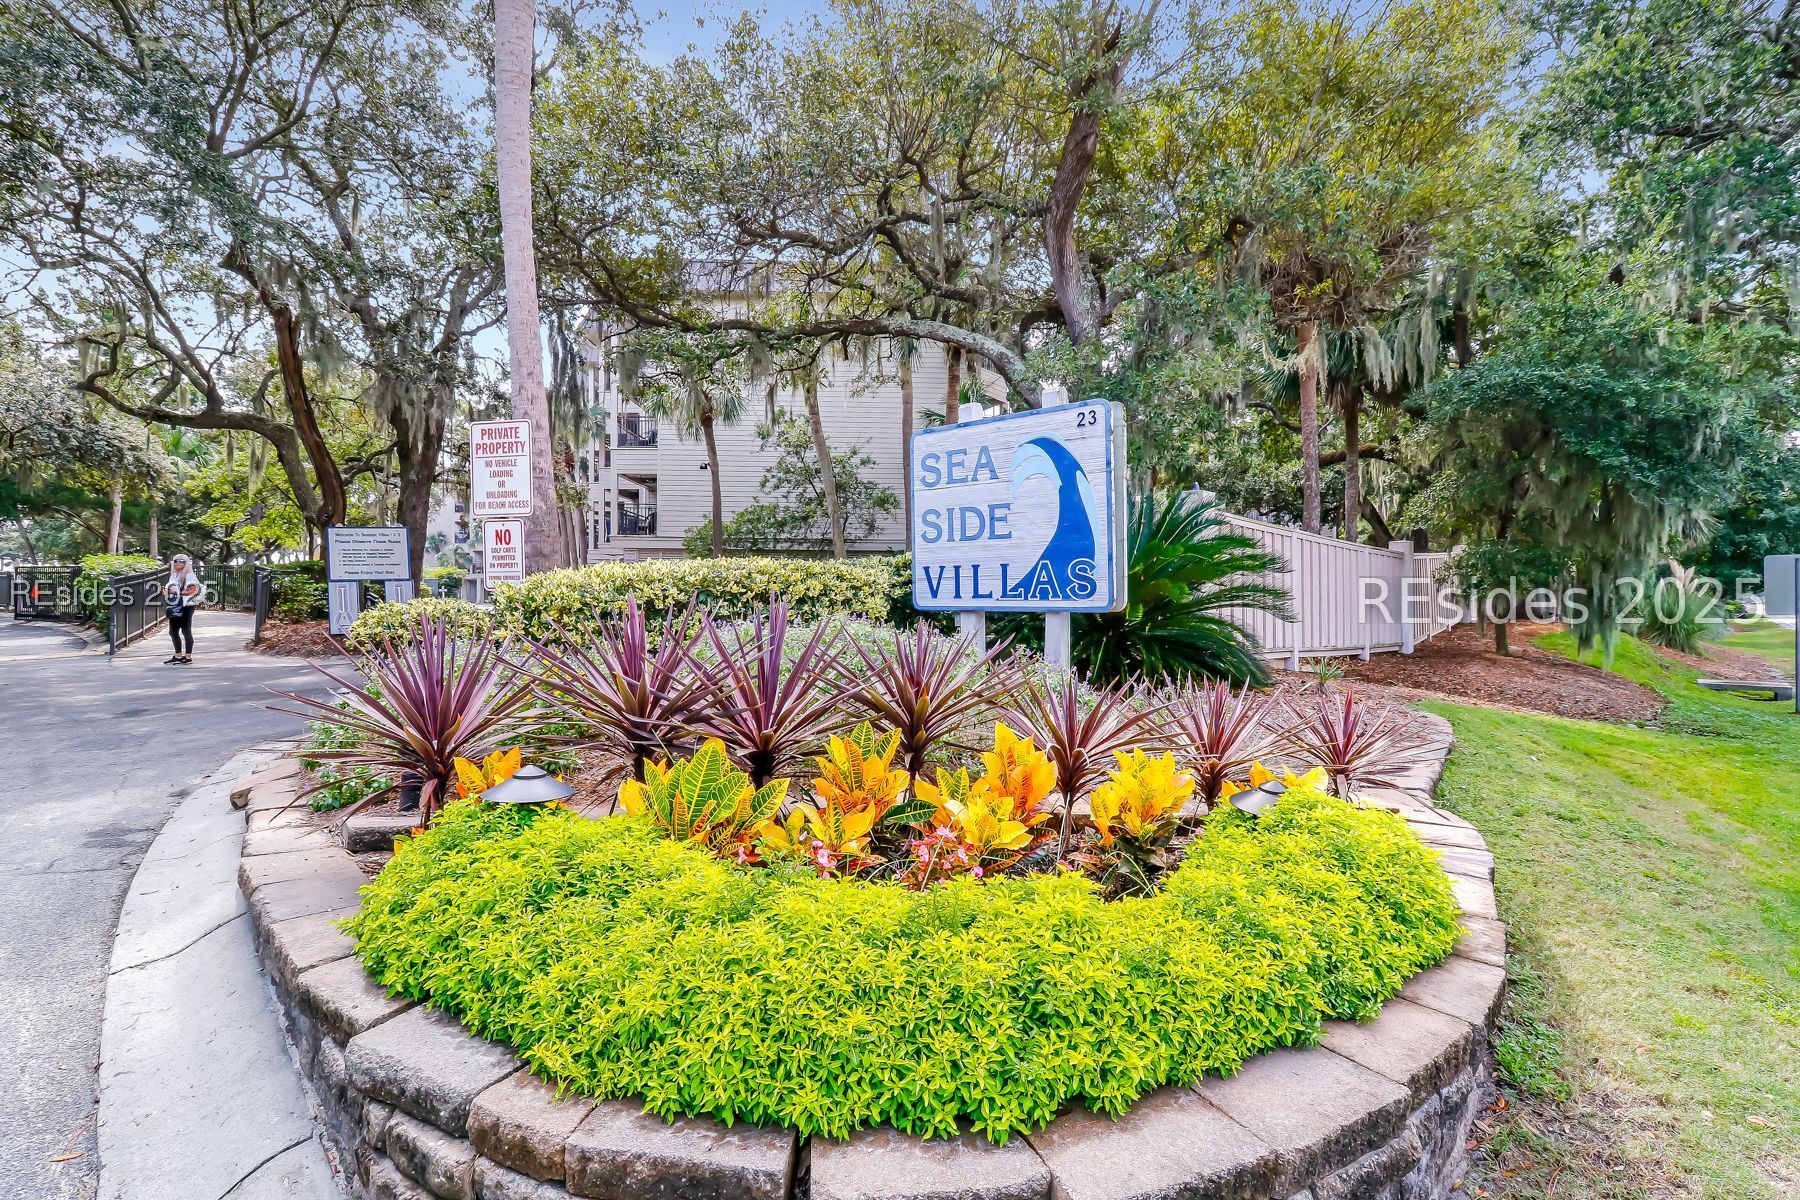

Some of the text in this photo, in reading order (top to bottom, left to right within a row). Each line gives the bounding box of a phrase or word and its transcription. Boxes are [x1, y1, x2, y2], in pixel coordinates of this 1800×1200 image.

[1076, 410, 1097, 428] 23
[481, 426, 520, 440] PRIVATE
[476, 441, 526, 455] PROPERTY
[495, 459, 517, 467] VEHICLE
[920, 445, 1000, 488] SEA
[490, 470, 513, 478] LOADING
[486, 490, 517, 499] UNLOADING
[475, 500, 529, 510] FOR BEACH ACCESS
[920, 502, 1012, 543] SIDE
[495, 529, 512, 545] NO
[923, 558, 1098, 601] VILLAS
